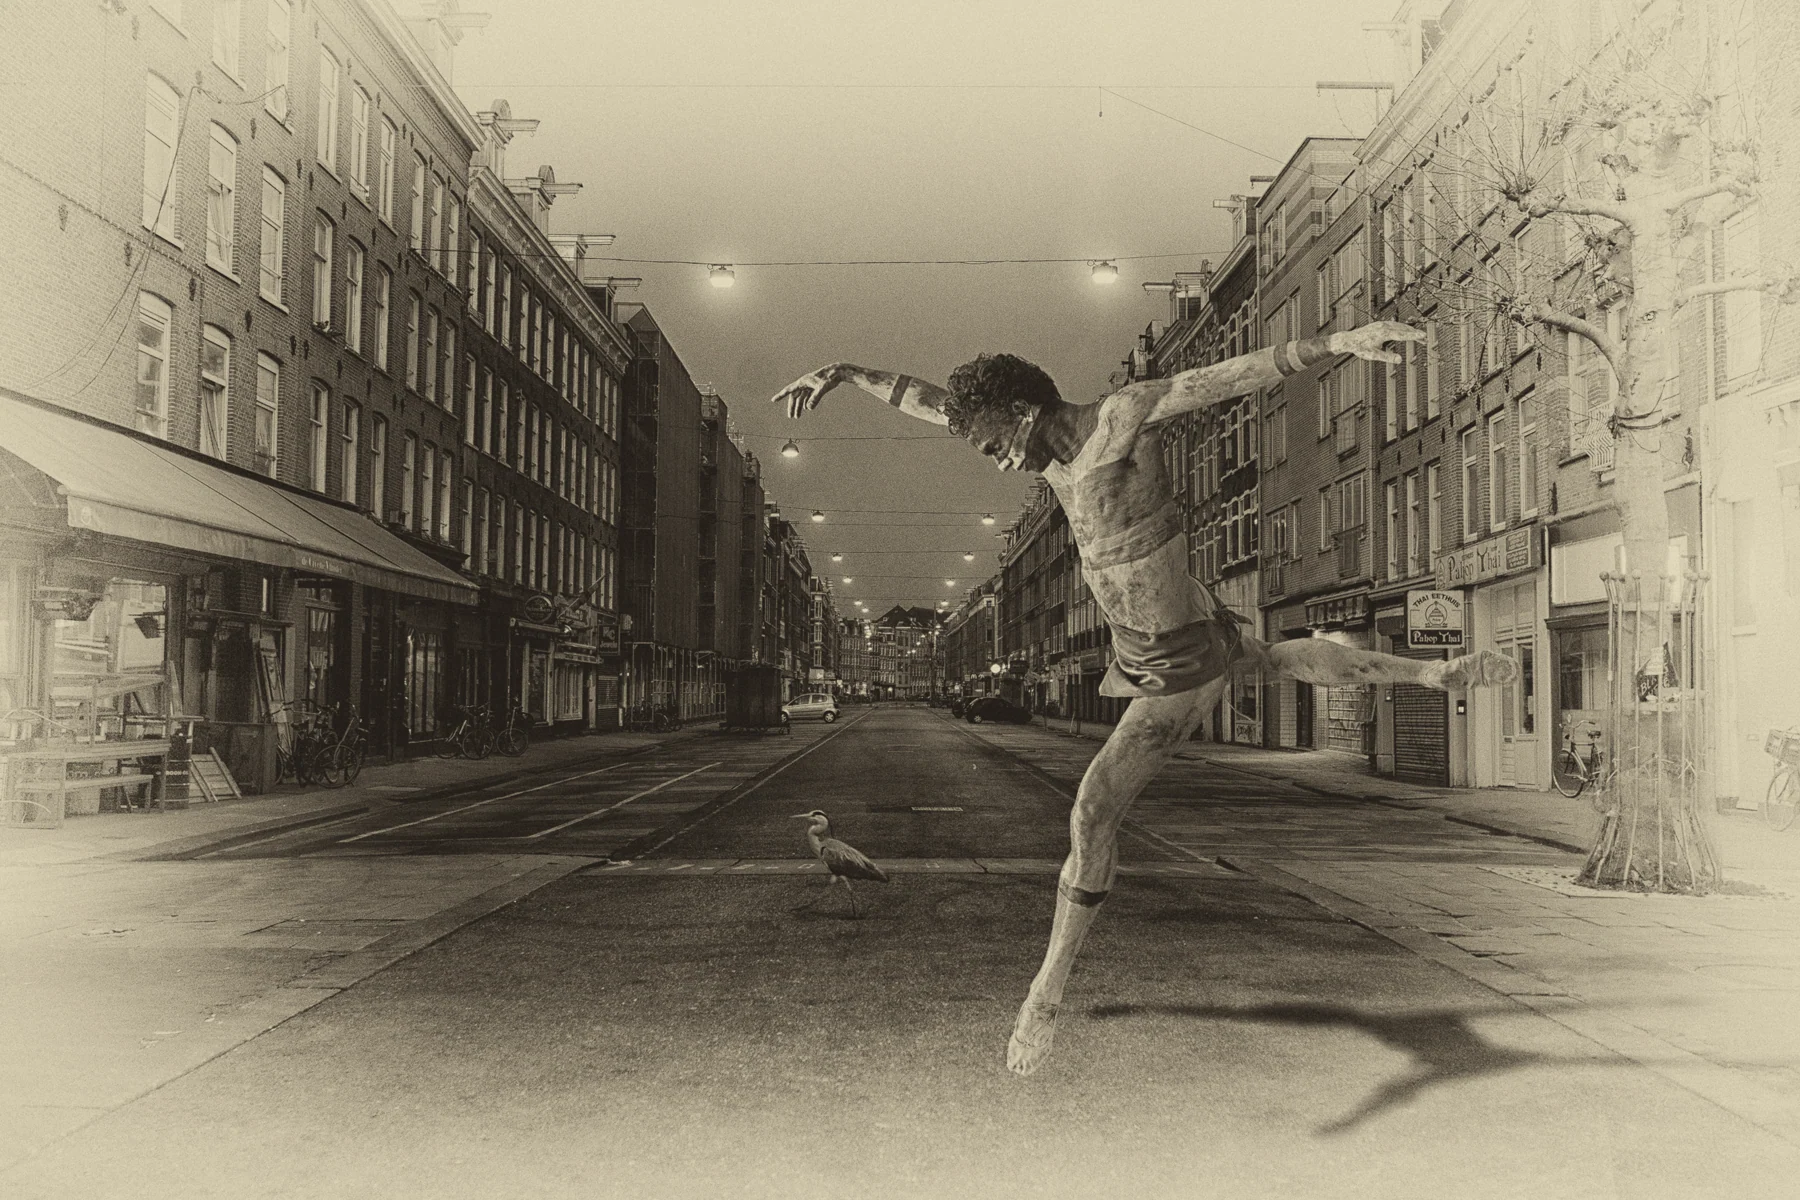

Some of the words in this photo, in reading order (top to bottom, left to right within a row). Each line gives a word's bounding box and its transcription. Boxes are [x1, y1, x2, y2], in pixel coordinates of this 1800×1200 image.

[1413, 595, 1429, 607] THAI
[1431, 593, 1461, 608] EETHUIS
[1412, 631, 1438, 644] Pahop
[1438, 631, 1461, 643] Thai
